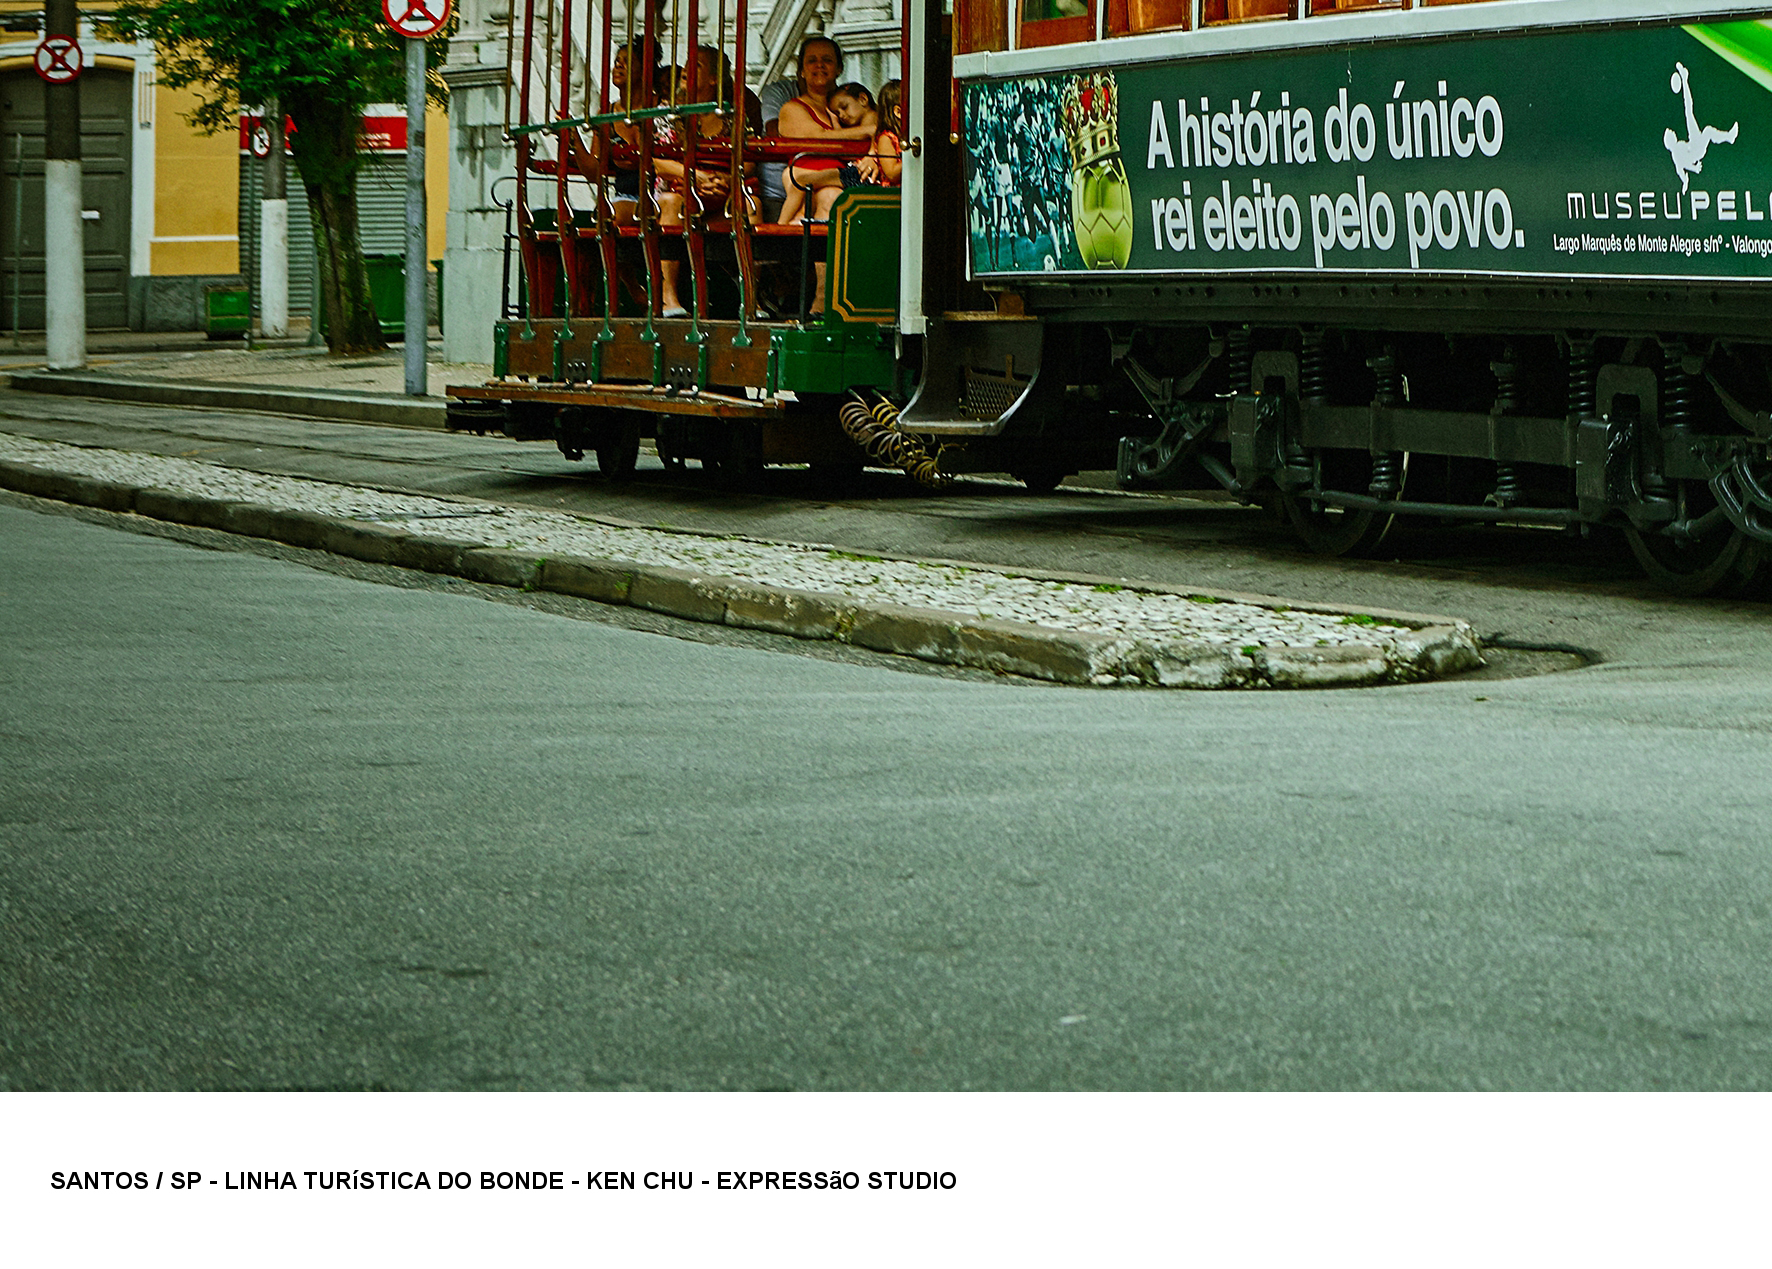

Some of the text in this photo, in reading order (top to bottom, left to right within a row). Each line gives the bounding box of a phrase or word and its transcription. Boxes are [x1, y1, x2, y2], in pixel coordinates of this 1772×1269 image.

[1147, 80, 1504, 169] A história do único
[1151, 175, 1525, 268] rei eleito pelo povo.
[1553, 233, 1580, 256] Largo
[1581, 233, 1623, 256] Marquês
[1623, 233, 1636, 252] de
[1637, 233, 1668, 253] Monte
[1669, 234, 1702, 257] Alegre
